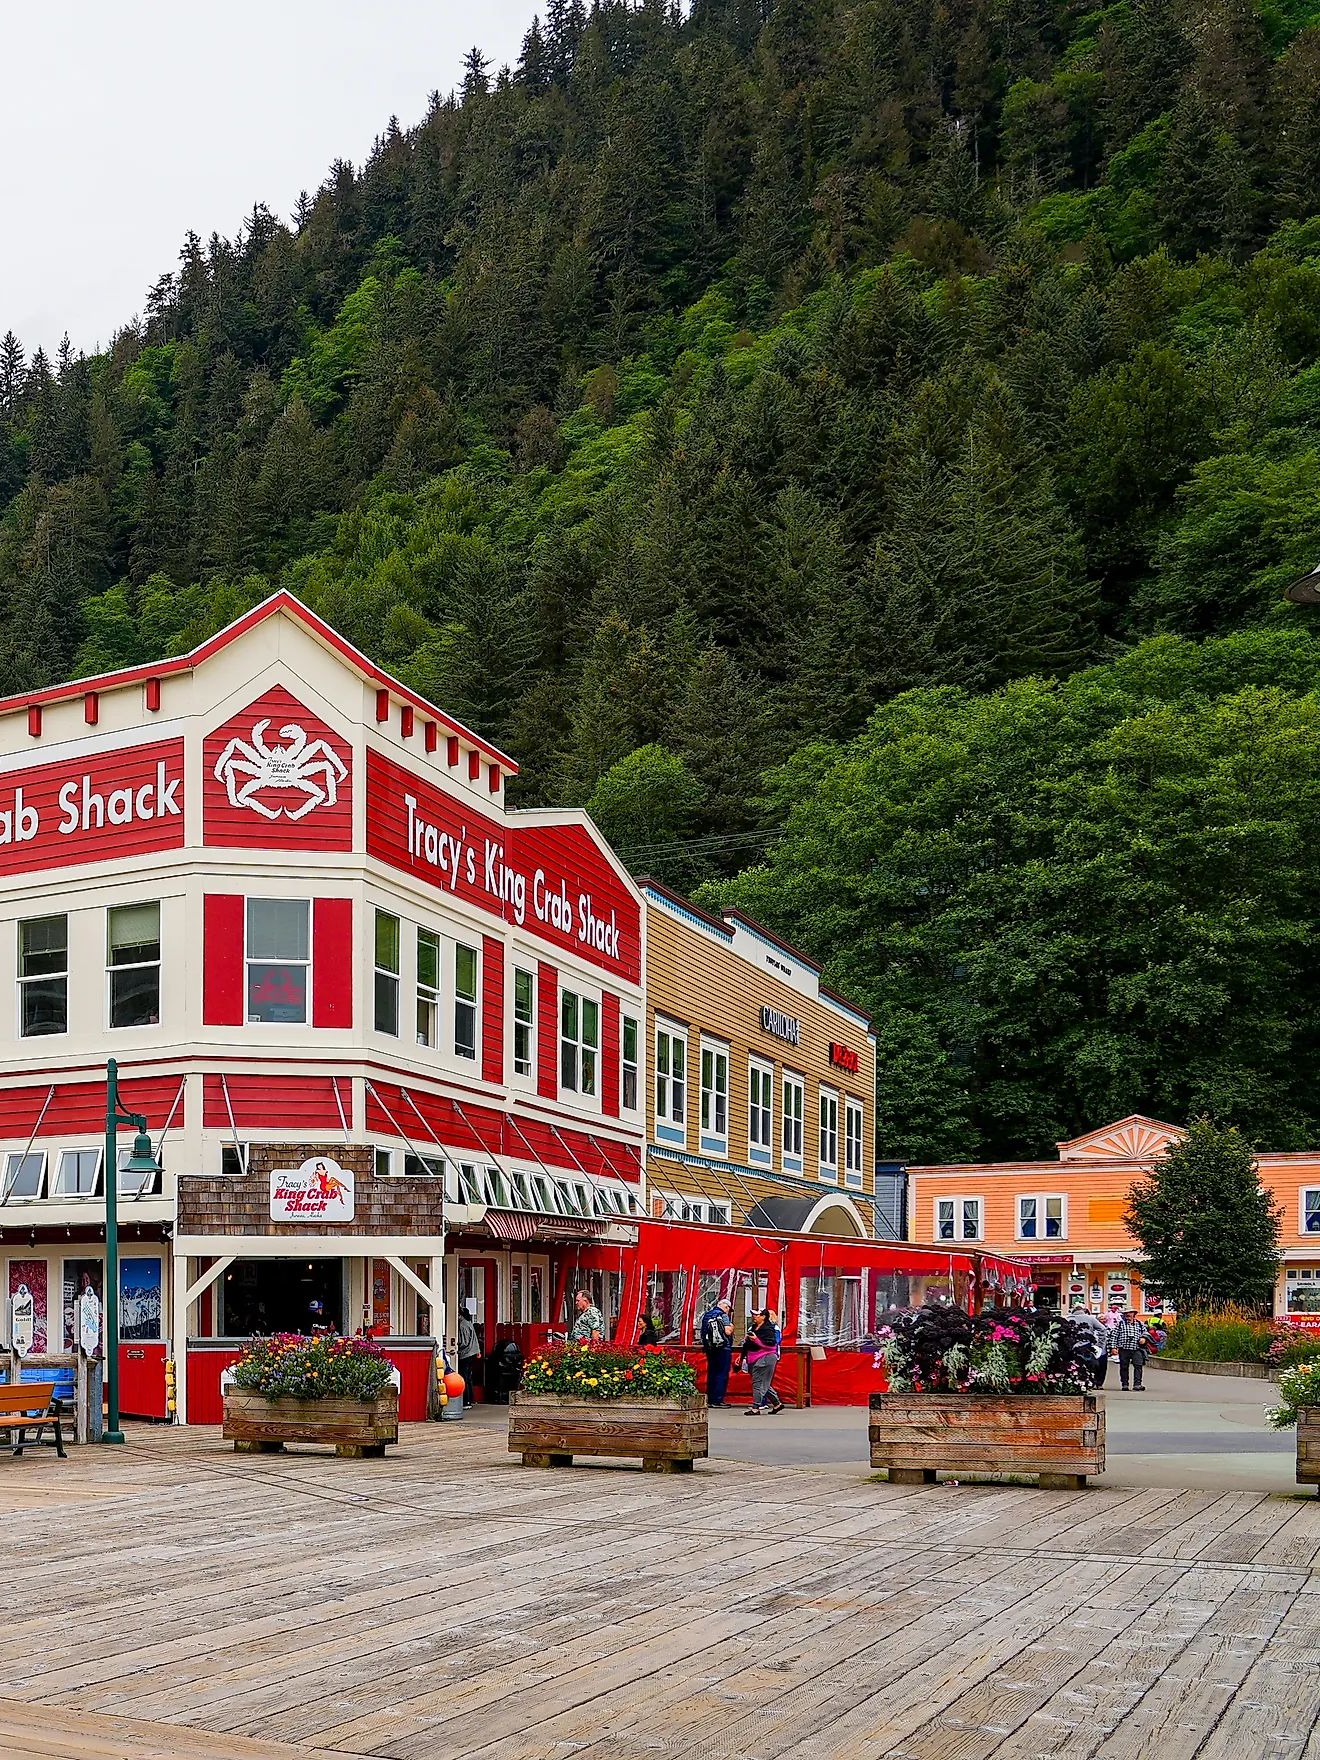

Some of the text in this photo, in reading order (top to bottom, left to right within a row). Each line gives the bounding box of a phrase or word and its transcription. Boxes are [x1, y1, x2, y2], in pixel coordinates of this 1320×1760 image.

[58, 761, 182, 834] Shack
[404, 793, 620, 961] Tracy's King Crab Shack
[763, 1005, 801, 1047] CARILOHA
[273, 1188, 339, 1202] King Crab
[277, 1175, 308, 1191] Tracy's
[284, 1199, 328, 1212] Shack
